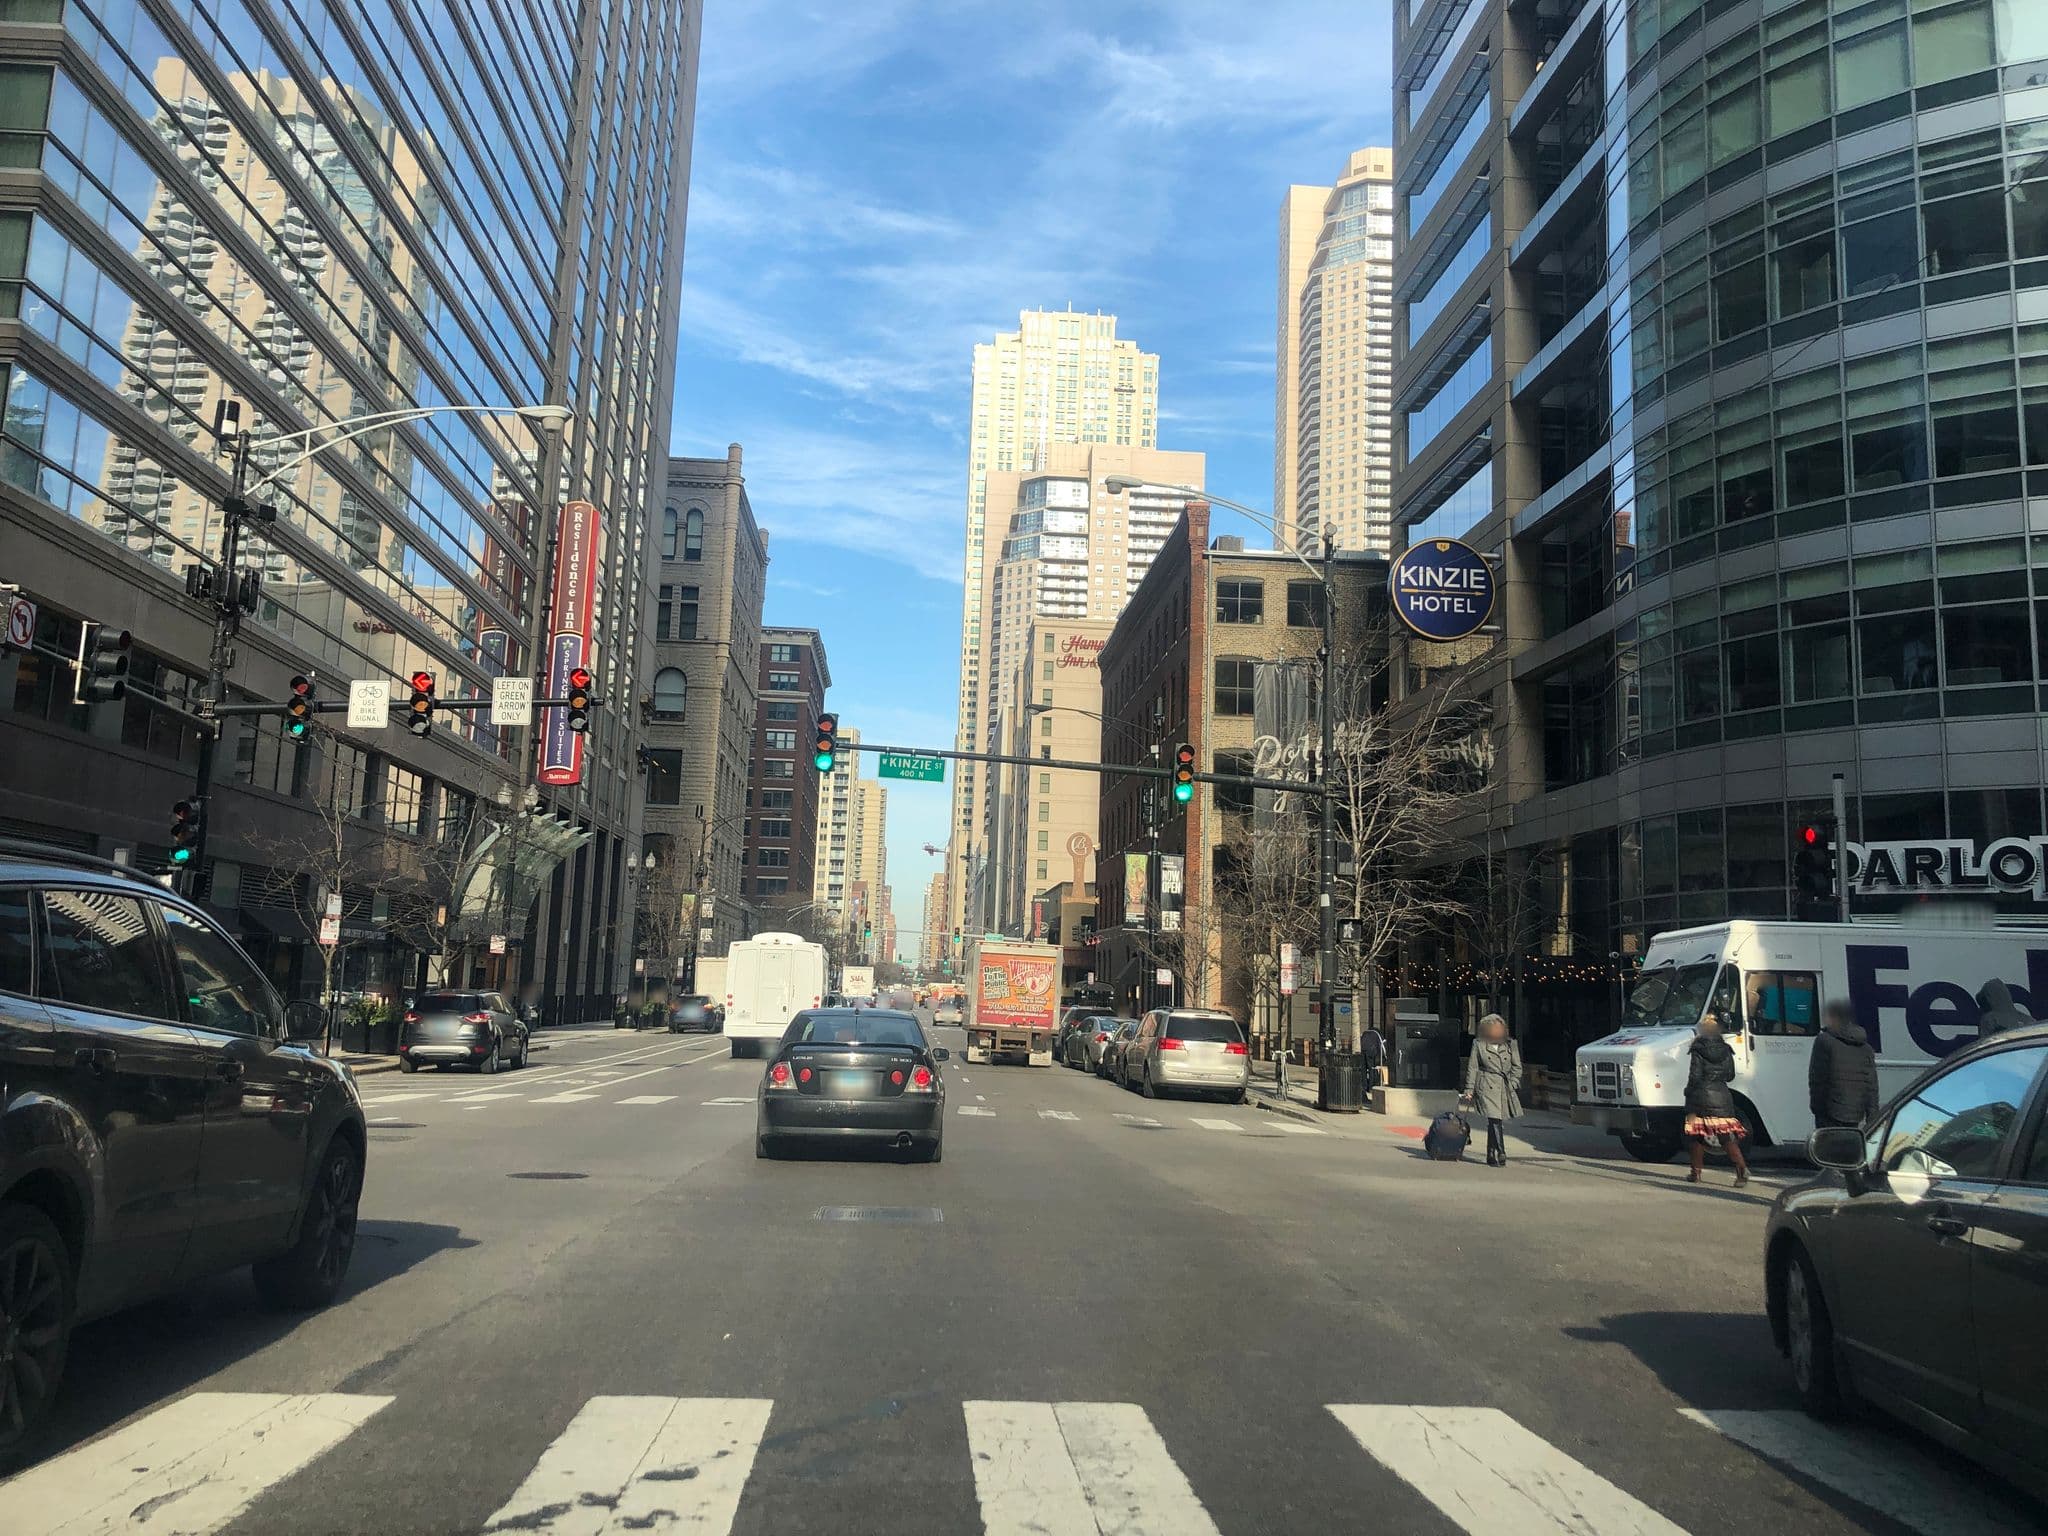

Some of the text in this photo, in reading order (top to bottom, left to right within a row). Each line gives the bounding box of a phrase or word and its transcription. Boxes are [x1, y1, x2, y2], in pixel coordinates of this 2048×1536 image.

[565, 512, 583, 629] Residence Inn
[1400, 565, 1487, 589] KINZIE
[1410, 595, 1477, 614] HOTEL
[1056, 653, 1089, 669] Inn
[496, 681, 530, 690] LEFT ON
[500, 692, 526, 700] GREEN
[498, 701, 527, 710] ARROW
[557, 650, 571, 764] SPRINGHLL SUITES
[501, 712, 521, 721] ONLY
[889, 757, 933, 771] KINZIE
[934, 762, 943, 770] ST
[899, 769, 925, 779] 400 N
[1828, 836, 2048, 901] PARLO
[1162, 870, 1180, 881] NOW
[1162, 882, 1181, 893] OPEN
